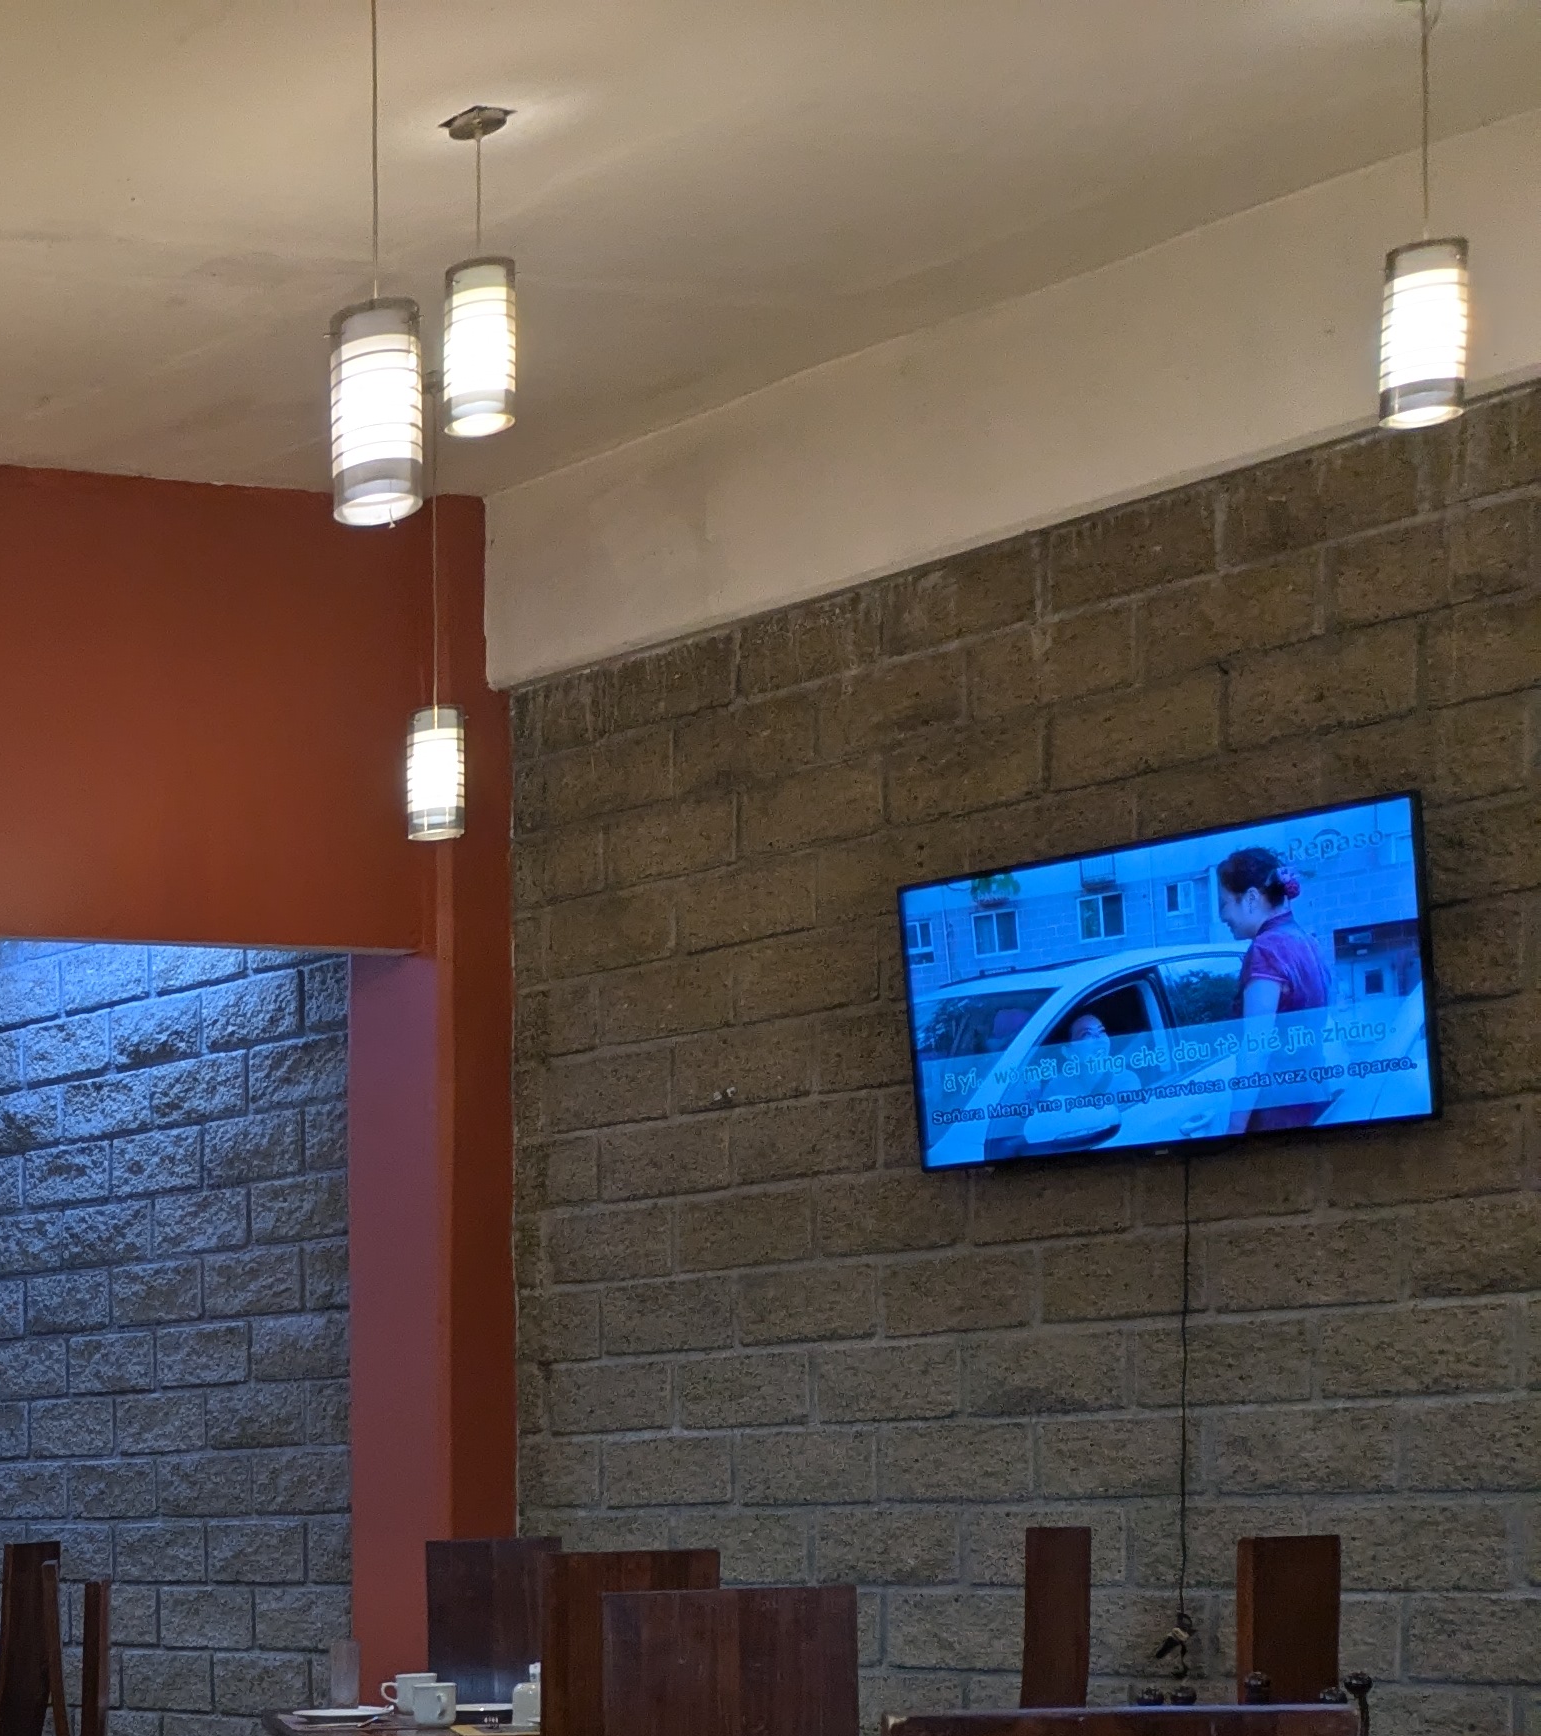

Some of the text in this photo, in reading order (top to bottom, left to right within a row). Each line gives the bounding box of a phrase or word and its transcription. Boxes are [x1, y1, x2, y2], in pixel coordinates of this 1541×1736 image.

[1287, 830, 1383, 861] Repaso
[1172, 1040, 1210, 1063] dōu
[1246, 1027, 1281, 1052] bié
[932, 1056, 1417, 1125] Señora Meng, me pongo muy nerviosa cada vez que aparco.
